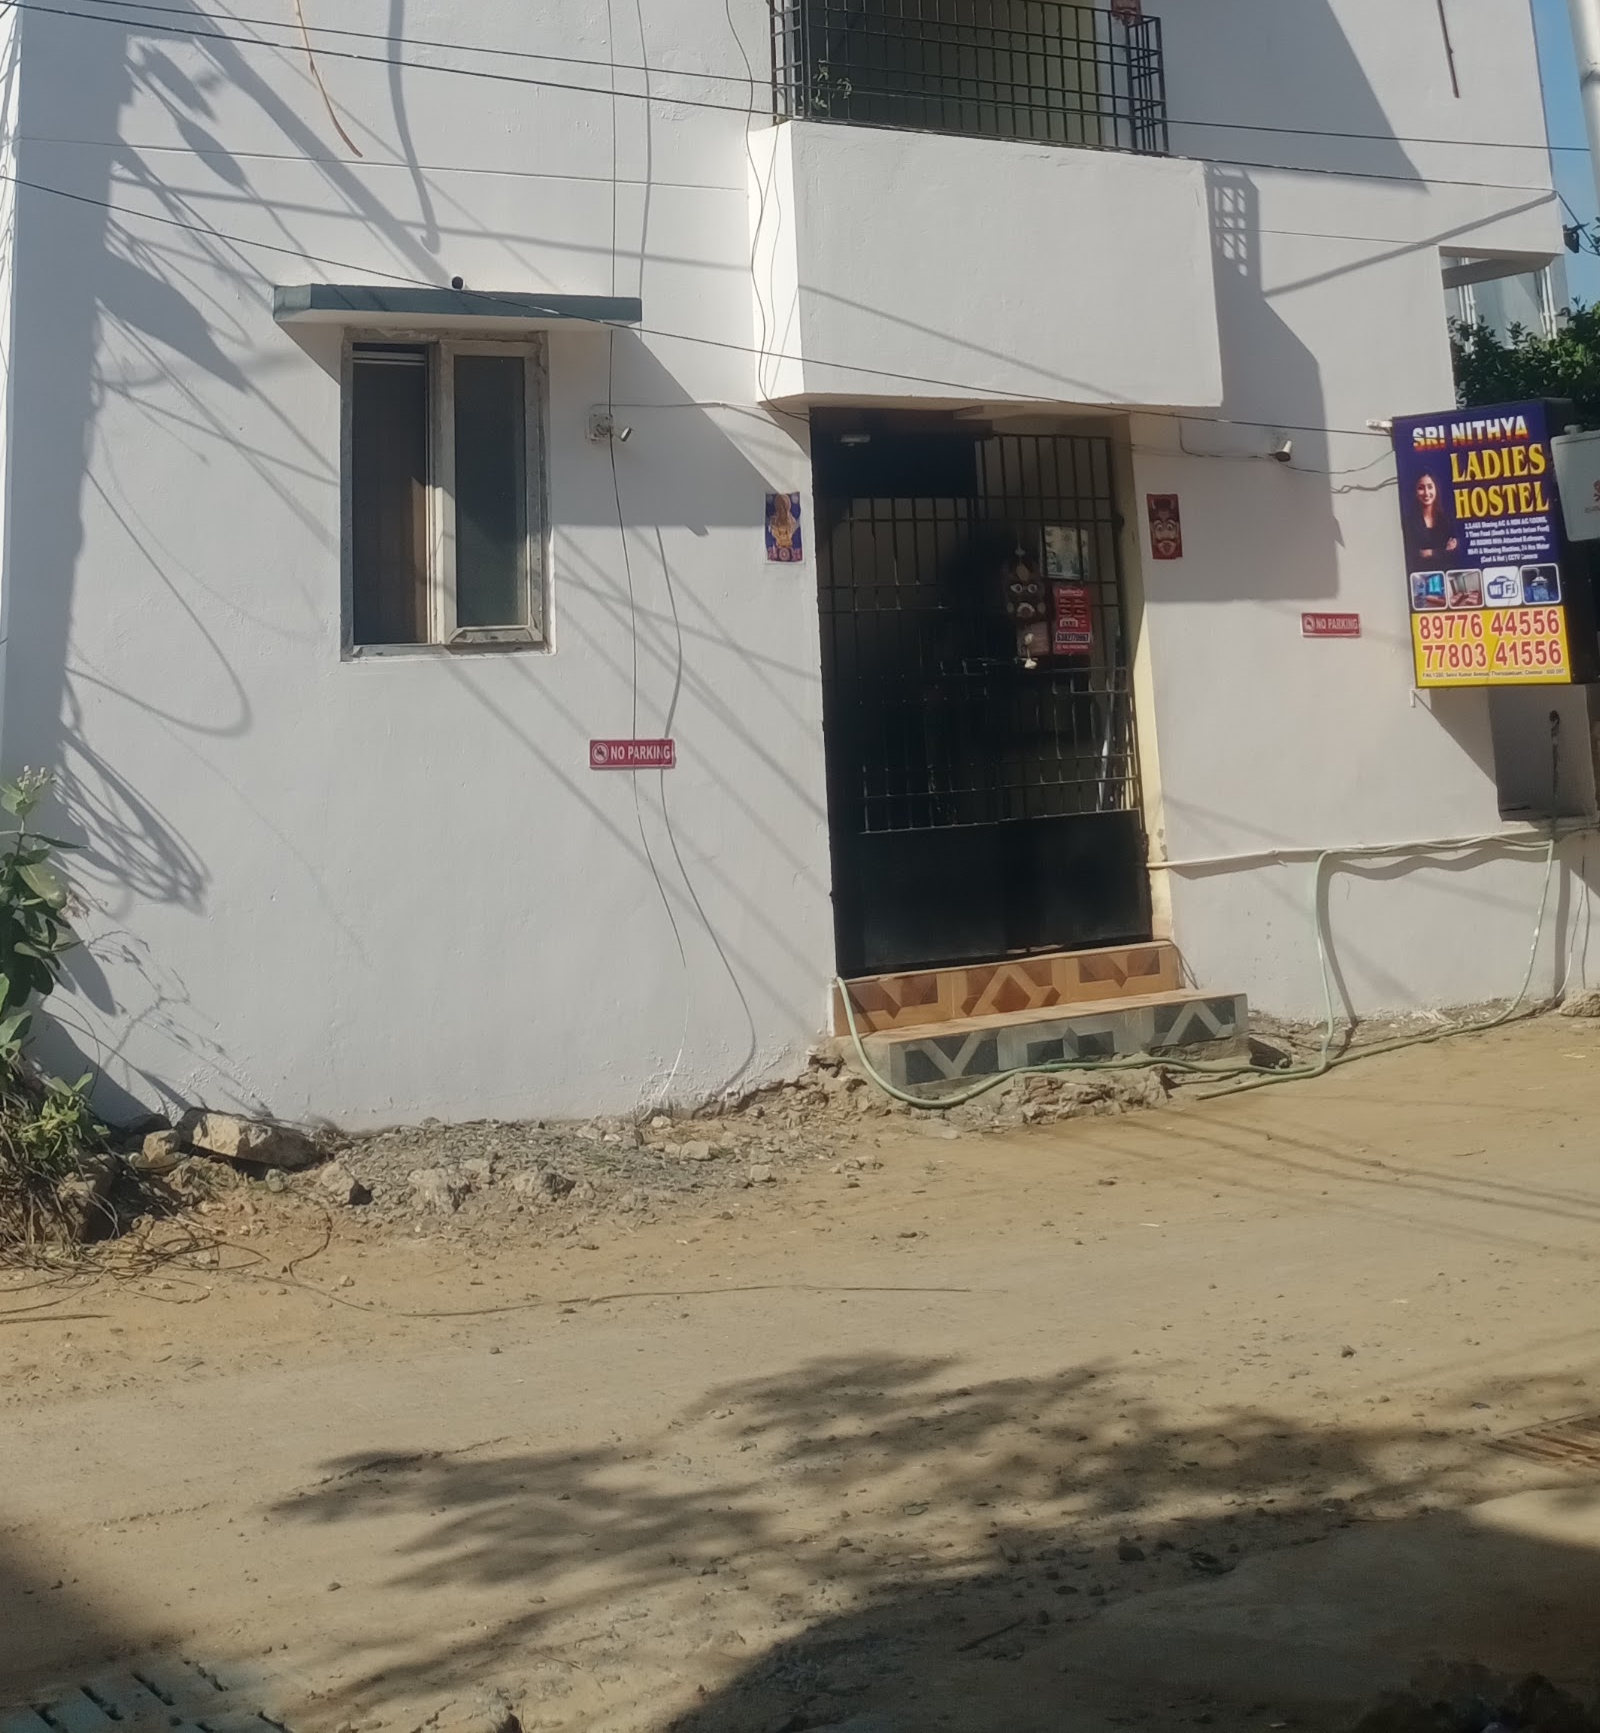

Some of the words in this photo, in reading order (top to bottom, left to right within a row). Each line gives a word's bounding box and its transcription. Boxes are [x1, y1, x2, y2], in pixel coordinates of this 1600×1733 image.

[1412, 427, 1445, 451] SRI
[1452, 416, 1529, 445] NITHYA
[1450, 443, 1547, 483] LADIES
[1453, 481, 1550, 519] HOSTEL
[1316, 618, 1326, 629] NO
[1328, 618, 1358, 629] PARKING
[1419, 614, 1482, 640] 89776
[1491, 609, 1560, 637] 44556
[1422, 643, 1487, 669] 77803
[1495, 639, 1562, 666] 41556
[610, 746, 625, 760] NO
[627, 745, 671, 760] PARKING
